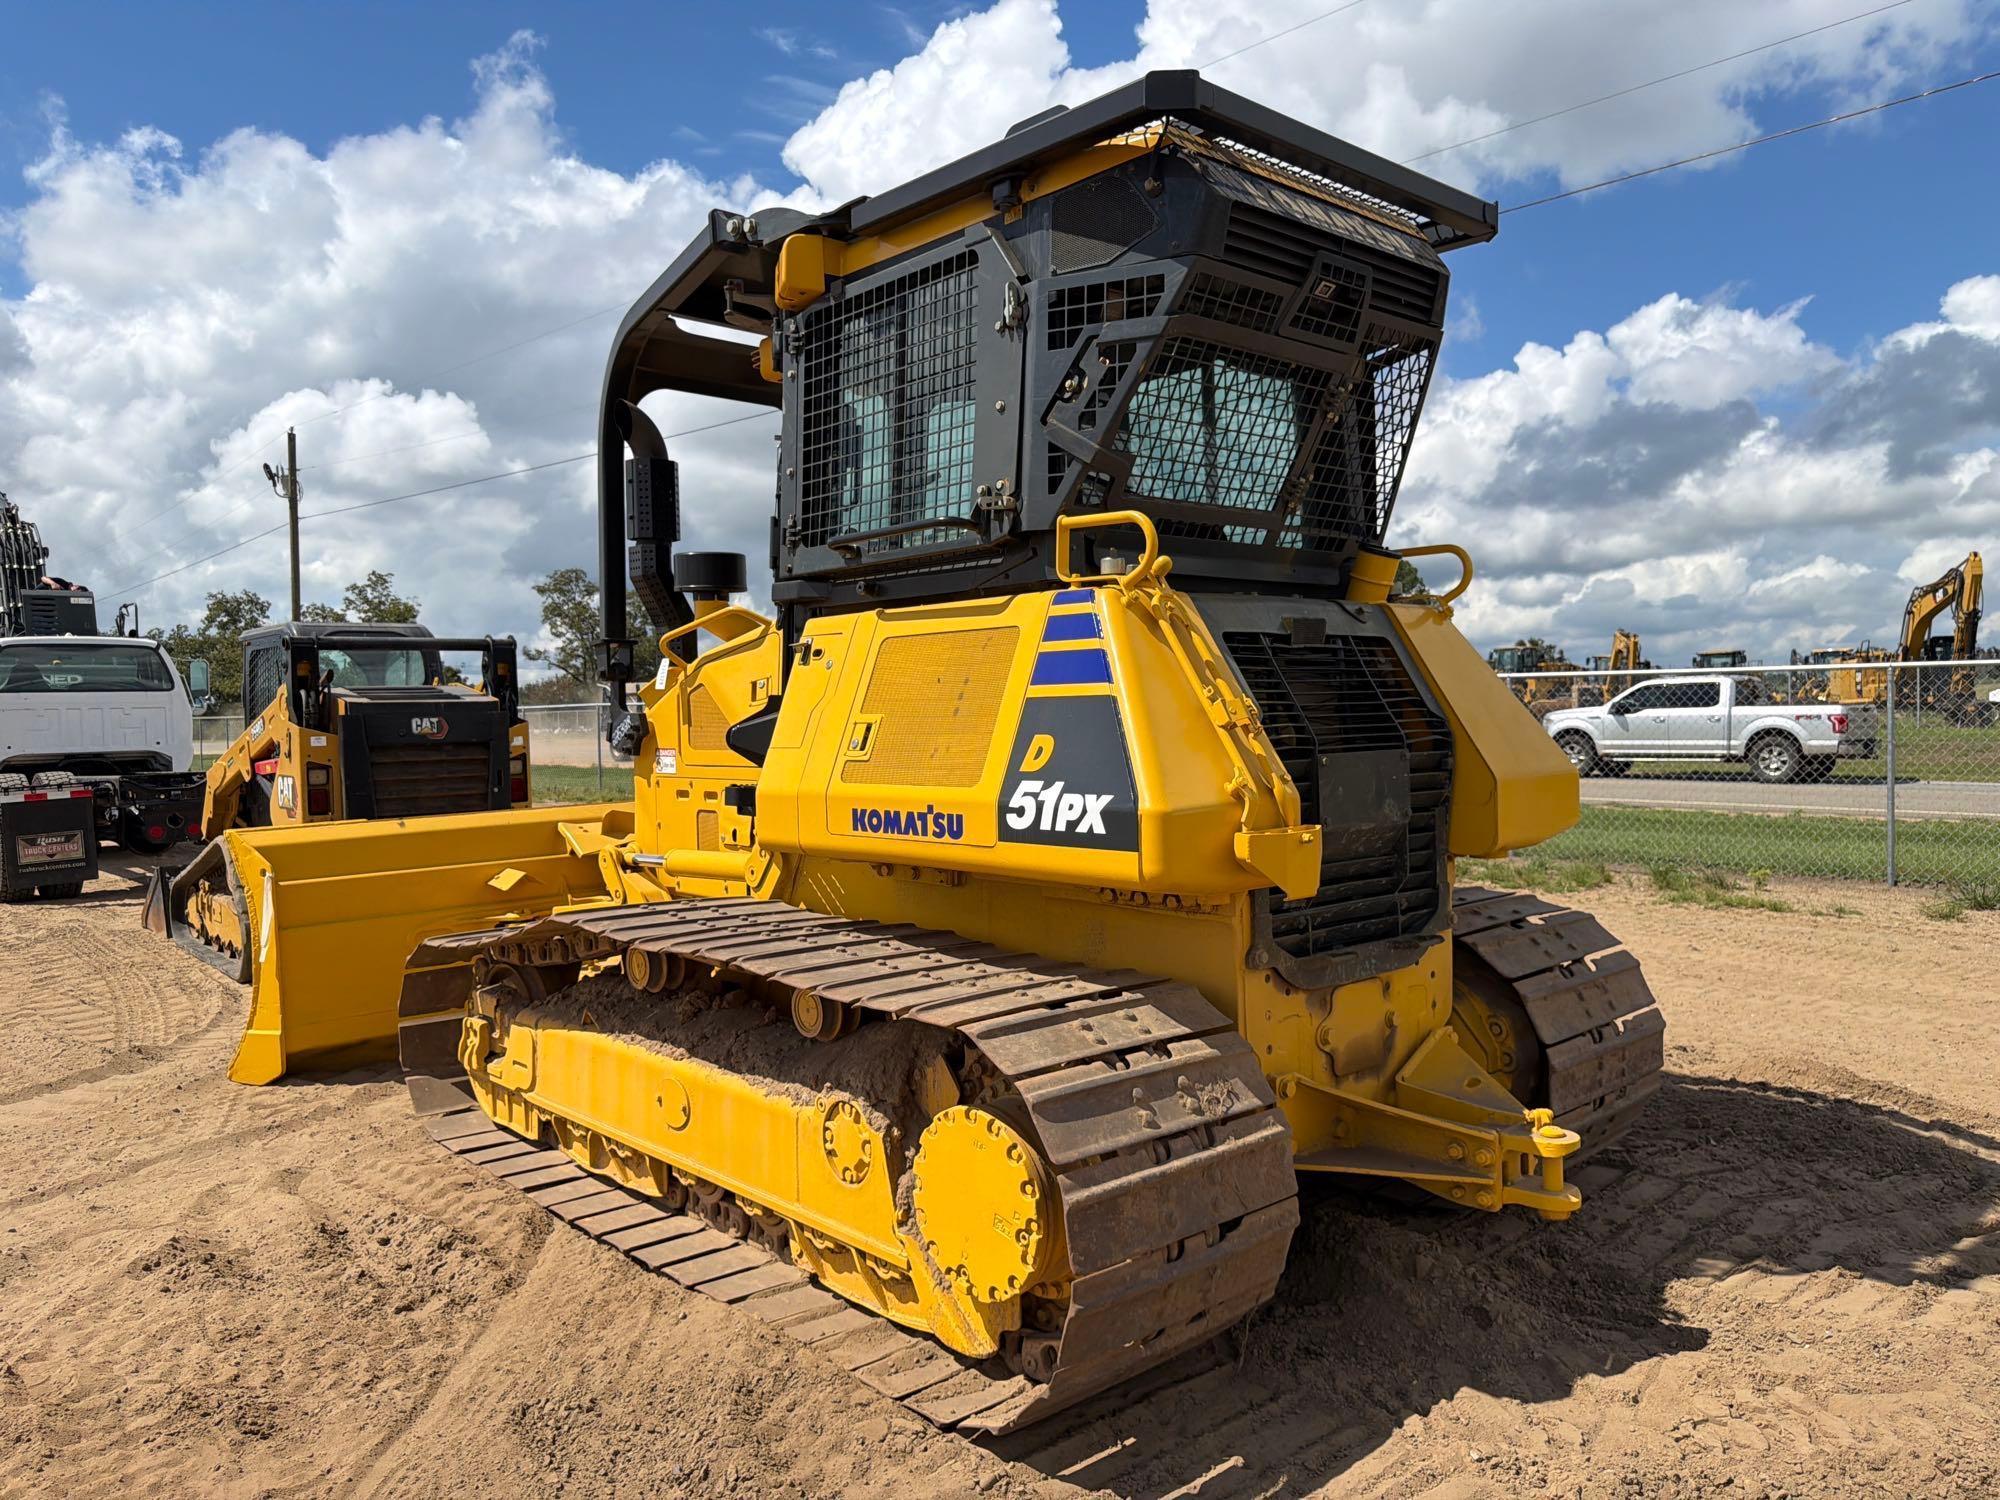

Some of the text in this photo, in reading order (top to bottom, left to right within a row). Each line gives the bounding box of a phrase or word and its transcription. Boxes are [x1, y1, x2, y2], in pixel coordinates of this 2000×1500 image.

[411, 717, 439, 735] CAT
[1019, 734, 1055, 772] D
[277, 776, 294, 809] CAT
[1006, 780, 1114, 835] 51PX
[851, 804, 964, 840] KOMATSU
[24, 843, 78, 855] TRUCK CENTERS
[18, 861, 87, 874] rushtruckcenters.com
